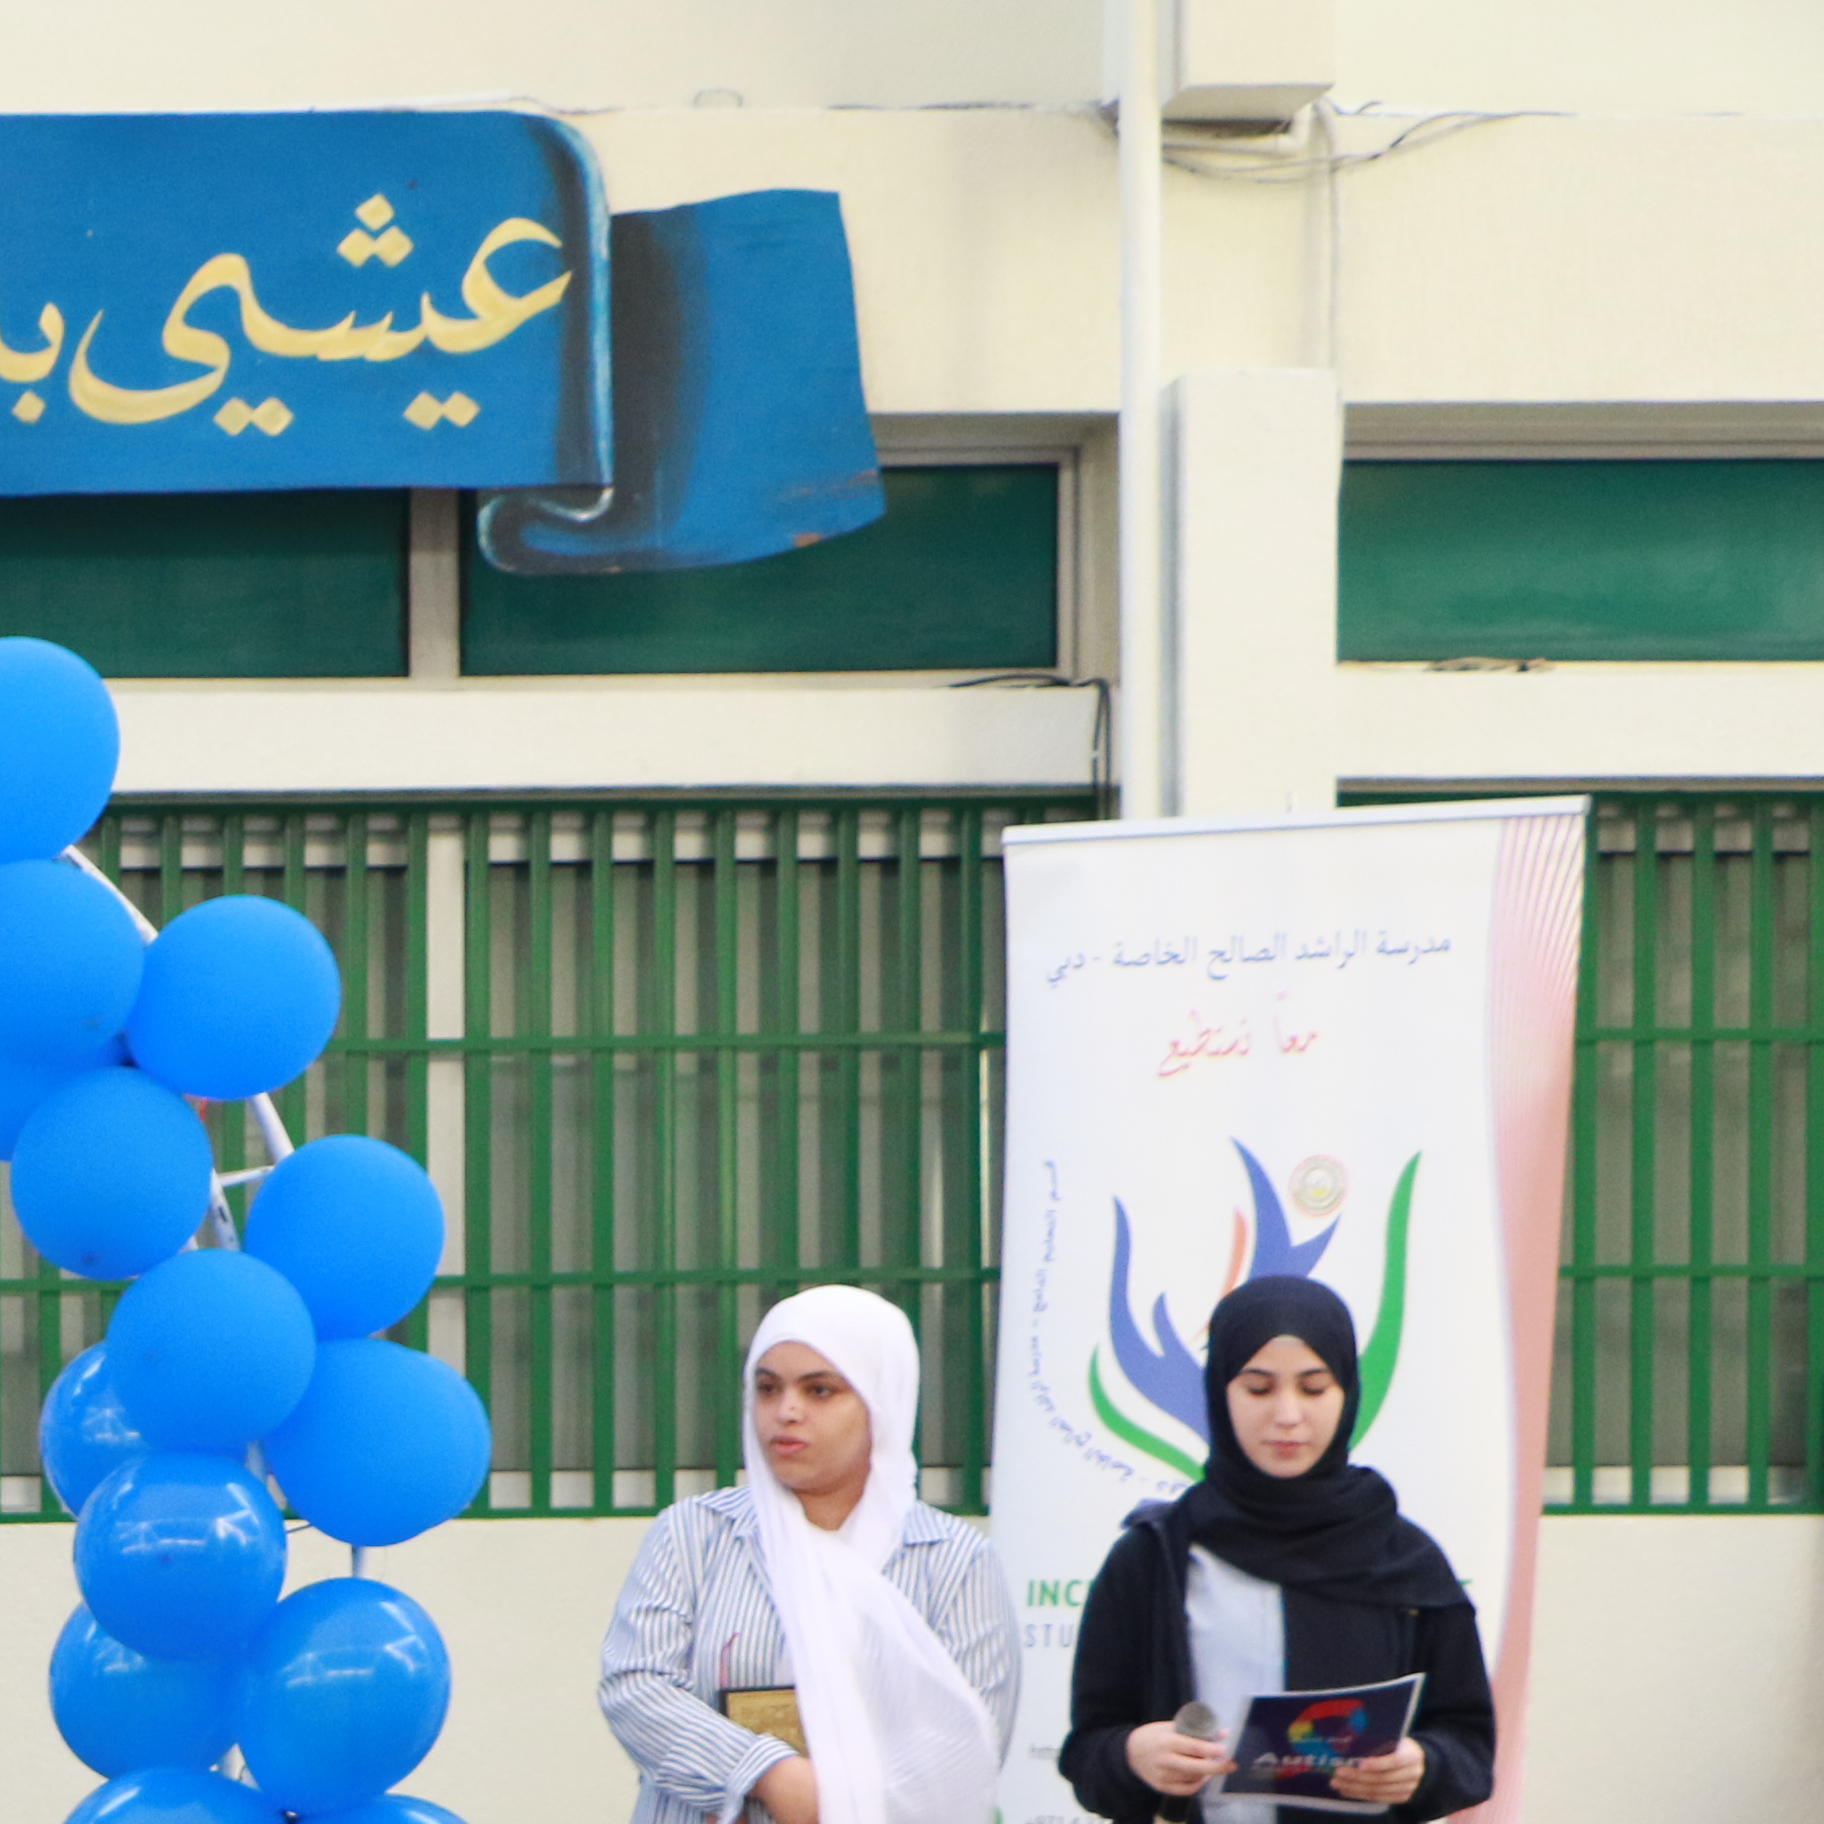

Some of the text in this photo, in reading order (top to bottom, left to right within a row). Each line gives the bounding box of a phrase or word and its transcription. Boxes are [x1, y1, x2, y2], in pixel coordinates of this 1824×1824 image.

[69, 192, 573, 438] عيشي
[1112, 934, 1199, 968] الخاصة
[1206, 932, 1287, 981] الصالح
[1295, 928, 1368, 971] الراشد
[1376, 929, 1451, 966] مدرسة
[1047, 951, 1088, 989] دبي
[1156, 1007, 1252, 1079] نستطيع
